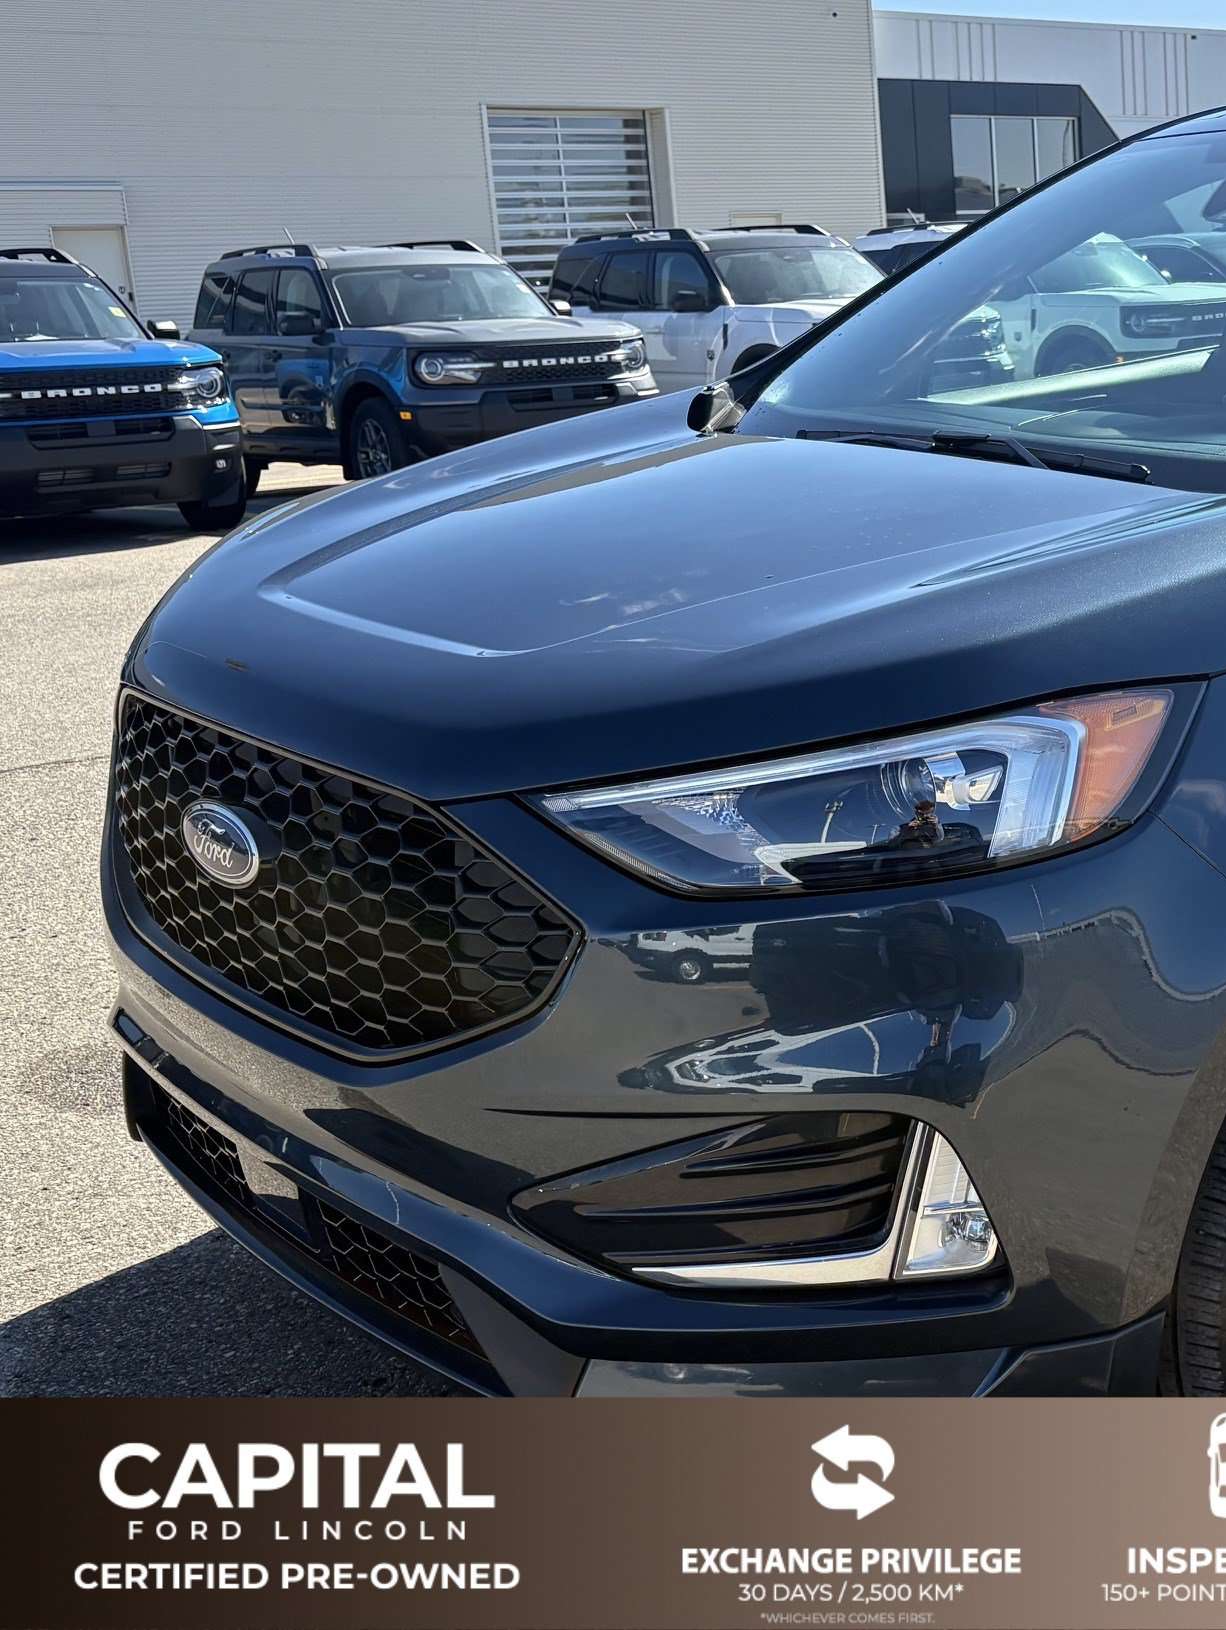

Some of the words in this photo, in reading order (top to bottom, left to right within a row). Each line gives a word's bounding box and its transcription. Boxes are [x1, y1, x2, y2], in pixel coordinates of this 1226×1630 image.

[502, 354, 609, 368] BRONCO
[20, 383, 163, 399] BRONCO
[193, 817, 235, 868] Ford
